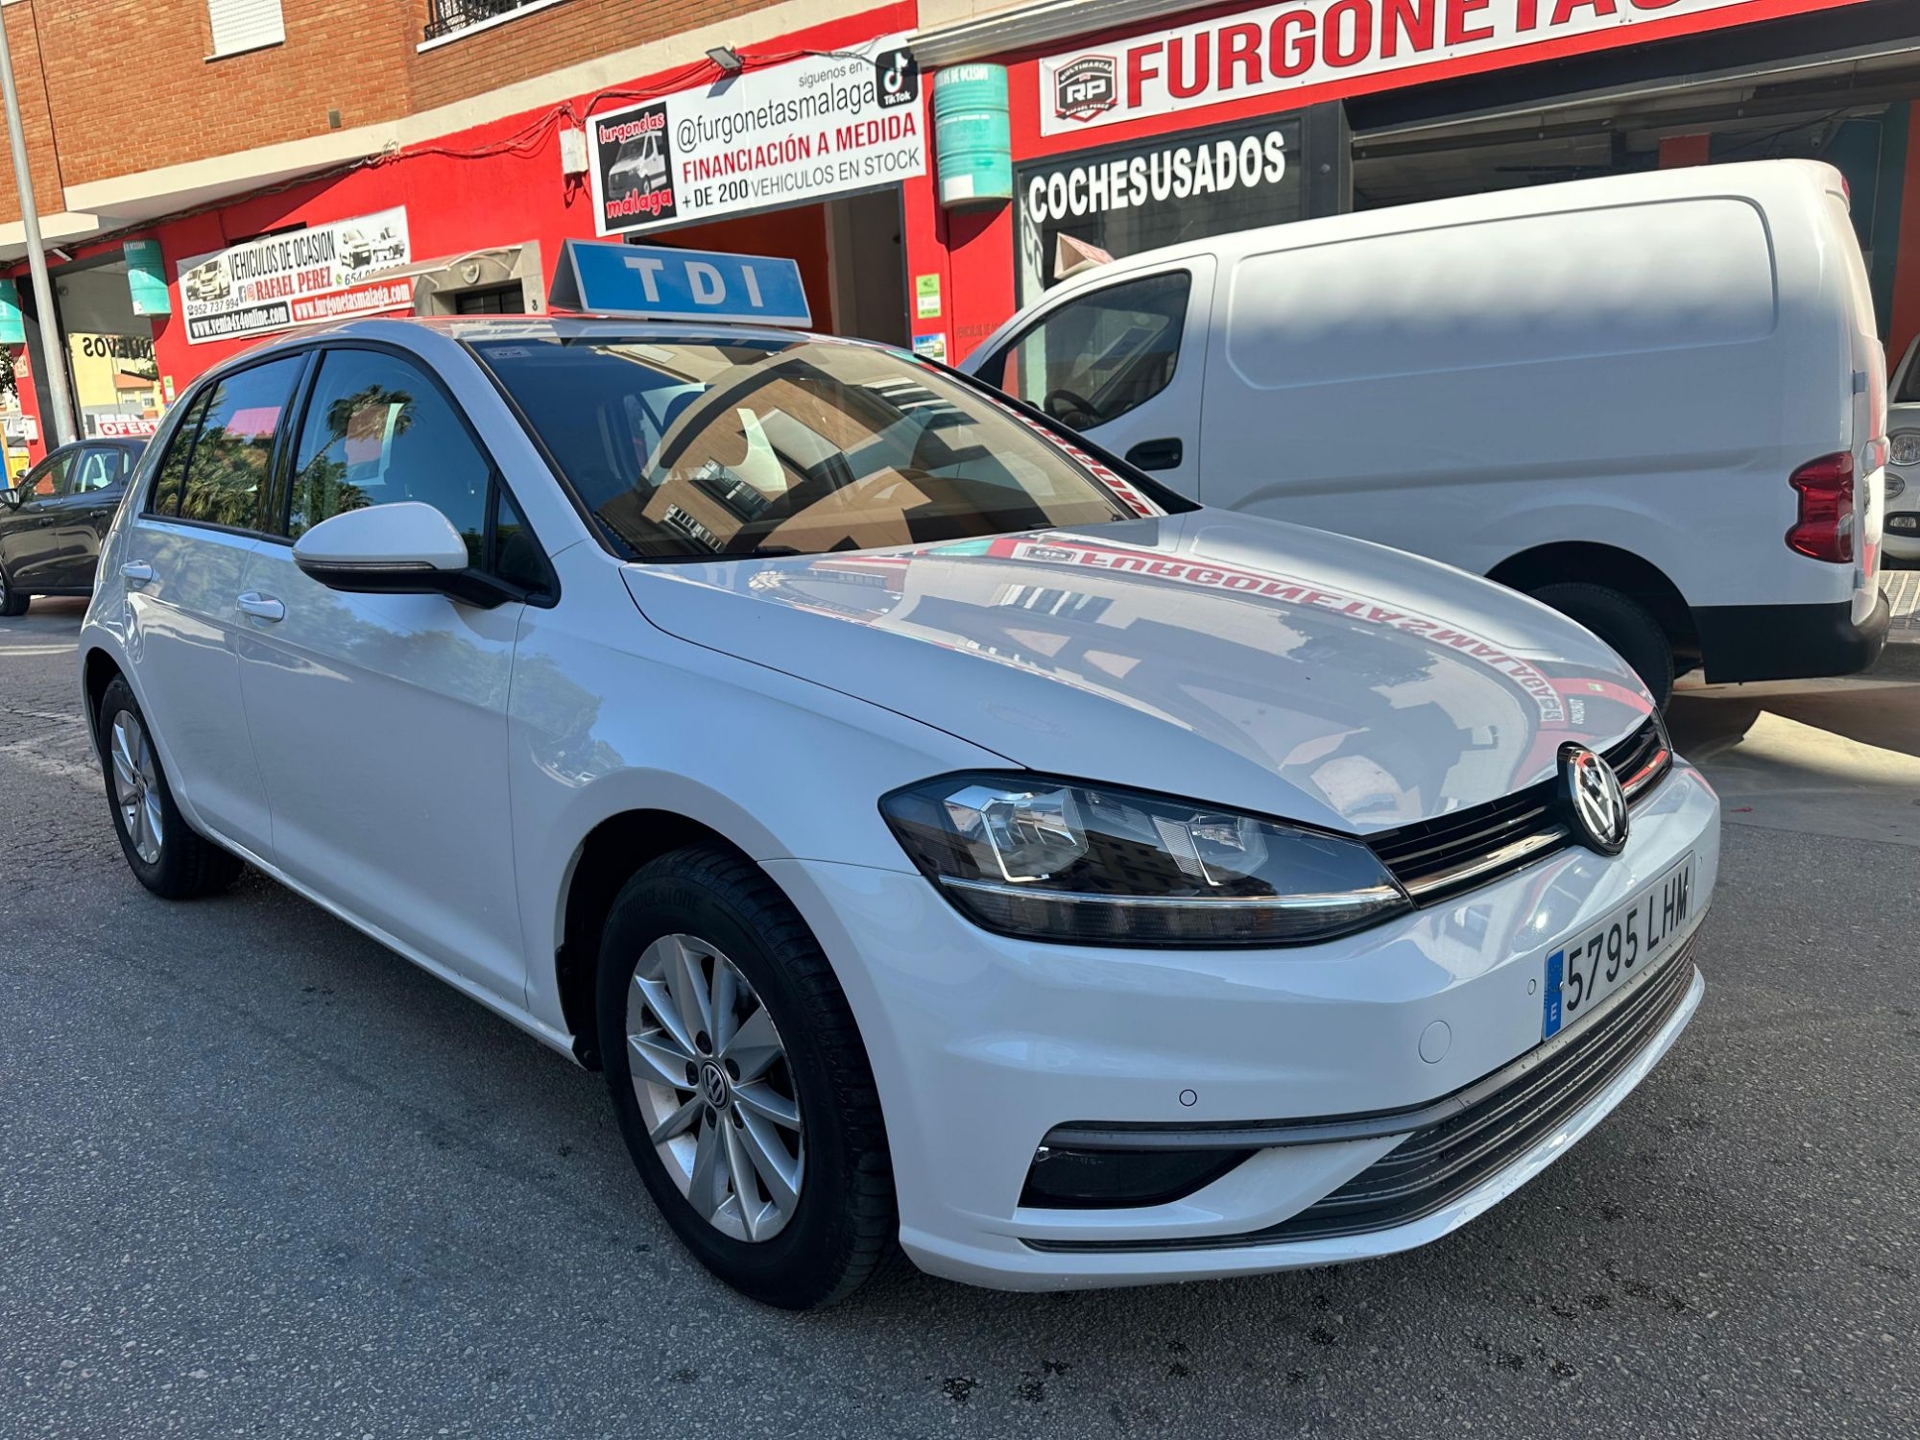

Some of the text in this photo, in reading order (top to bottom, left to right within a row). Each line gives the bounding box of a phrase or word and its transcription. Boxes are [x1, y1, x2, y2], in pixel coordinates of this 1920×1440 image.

[849, 62, 863, 74] en
[1126, 0, 1682, 108] FURGONE
[883, 90, 911, 105] TikTok
[1066, 79, 1107, 104] RP
[677, 81, 876, 153] @furgonetasmalaga
[682, 111, 917, 184] FINANCIACIÓN A MEDIDA
[694, 186, 714, 208] DE
[718, 179, 748, 203] 200
[750, 164, 835, 198] VEHICULOS
[838, 159, 860, 181] EN
[864, 147, 920, 176] STOCK
[606, 187, 673, 218] málaga
[228, 229, 336, 282] VEHICULOS DE OCASION
[255, 274, 295, 301] RAFAEL
[296, 266, 333, 293] PEREZ
[623, 256, 764, 308] TDI
[194, 297, 239, 316] 952 737 994
[293, 283, 411, 320] www.furgonetasmalaga.com
[191, 306, 289, 338] www.venta4x4online.com
[1566, 866, 1690, 1012] 5795 LHM
